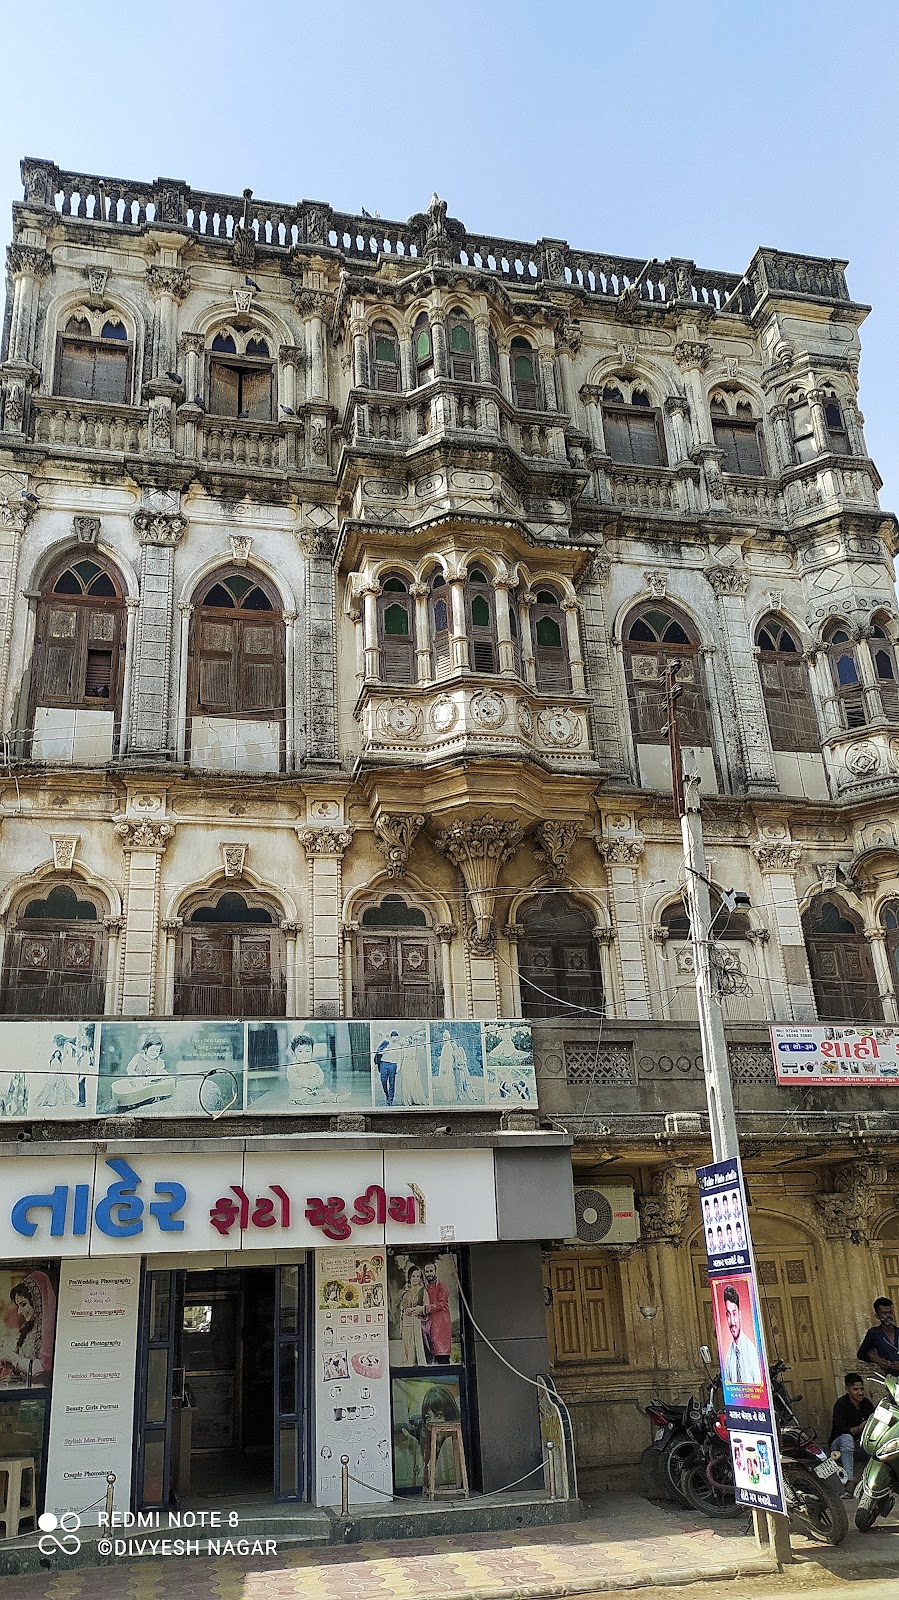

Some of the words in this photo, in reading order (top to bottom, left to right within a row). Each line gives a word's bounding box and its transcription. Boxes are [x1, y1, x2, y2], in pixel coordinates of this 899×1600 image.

[820, 1036, 880, 1059] શાહી
[11, 1159, 186, 1238] તાહેર
[209, 1184, 290, 1236] ફોટો
